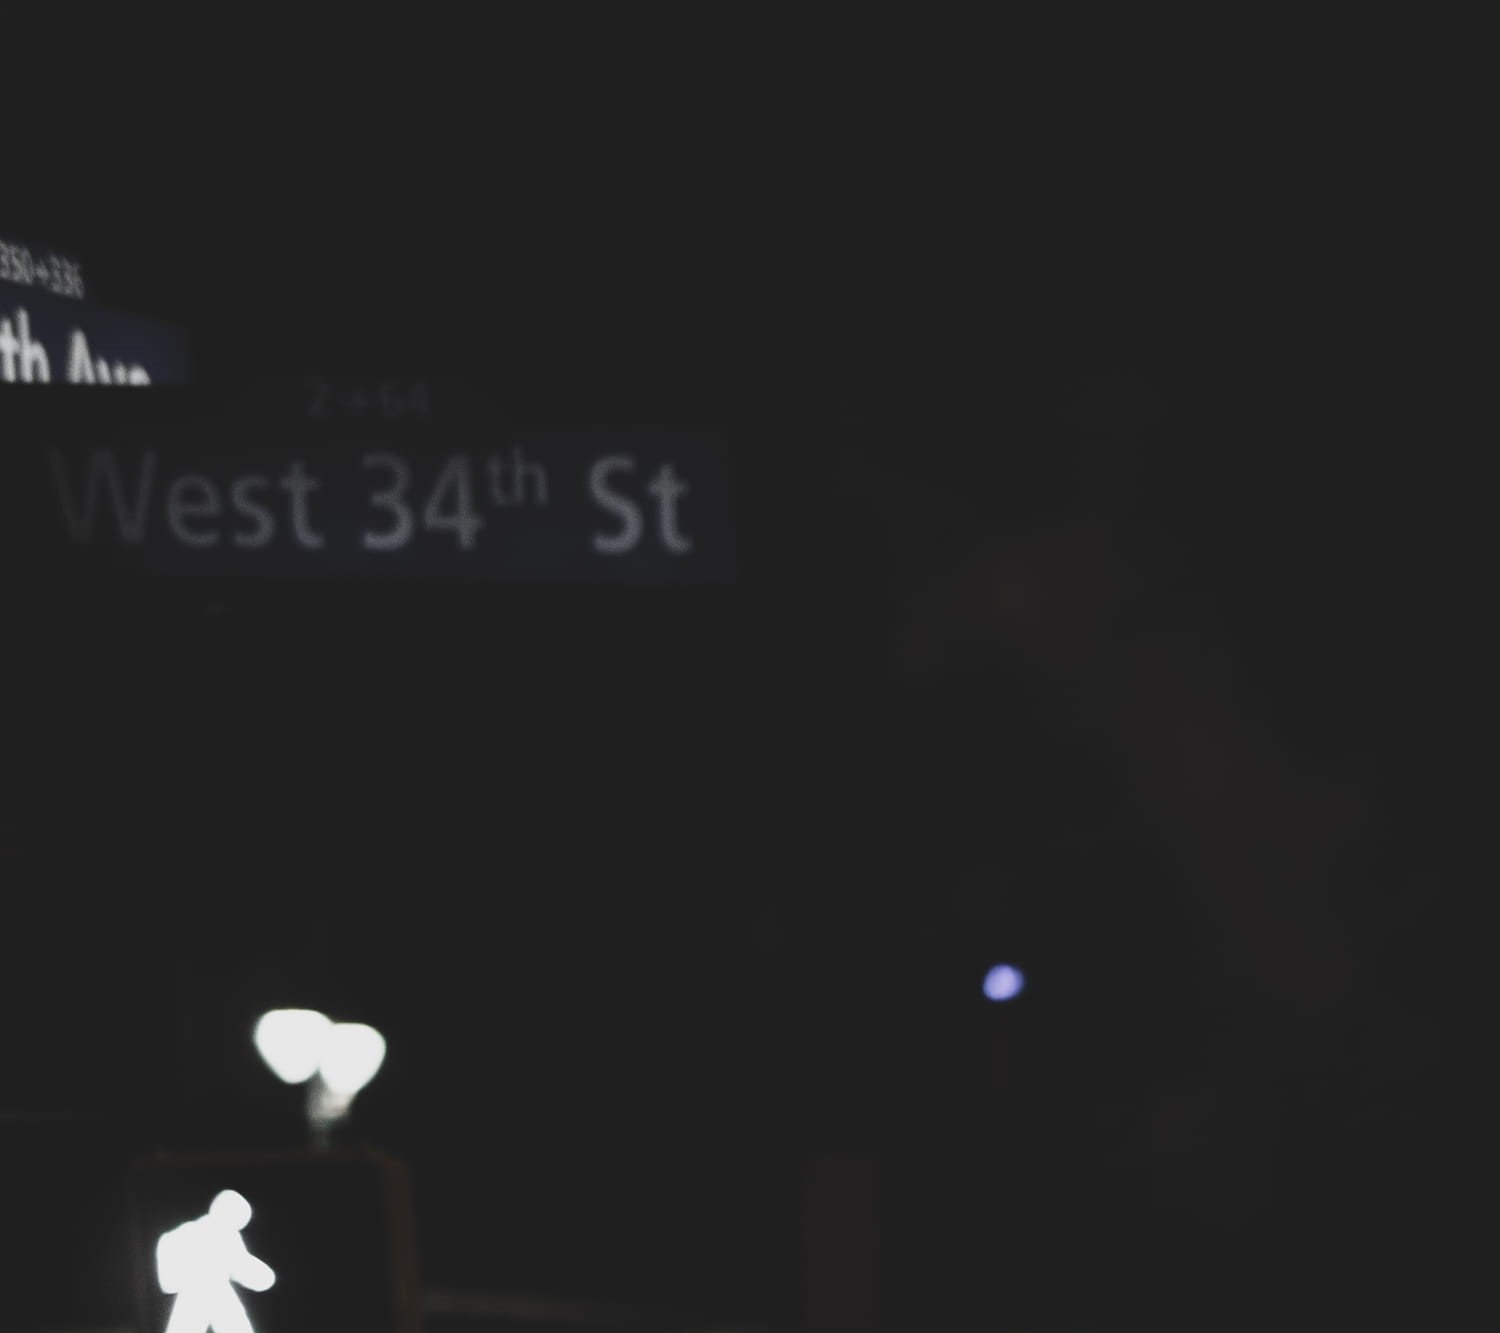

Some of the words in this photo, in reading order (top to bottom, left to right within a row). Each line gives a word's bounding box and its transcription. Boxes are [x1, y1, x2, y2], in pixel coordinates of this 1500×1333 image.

[45, 444, 326, 551] West
[359, 441, 551, 552] 34th
[587, 450, 695, 557] St
